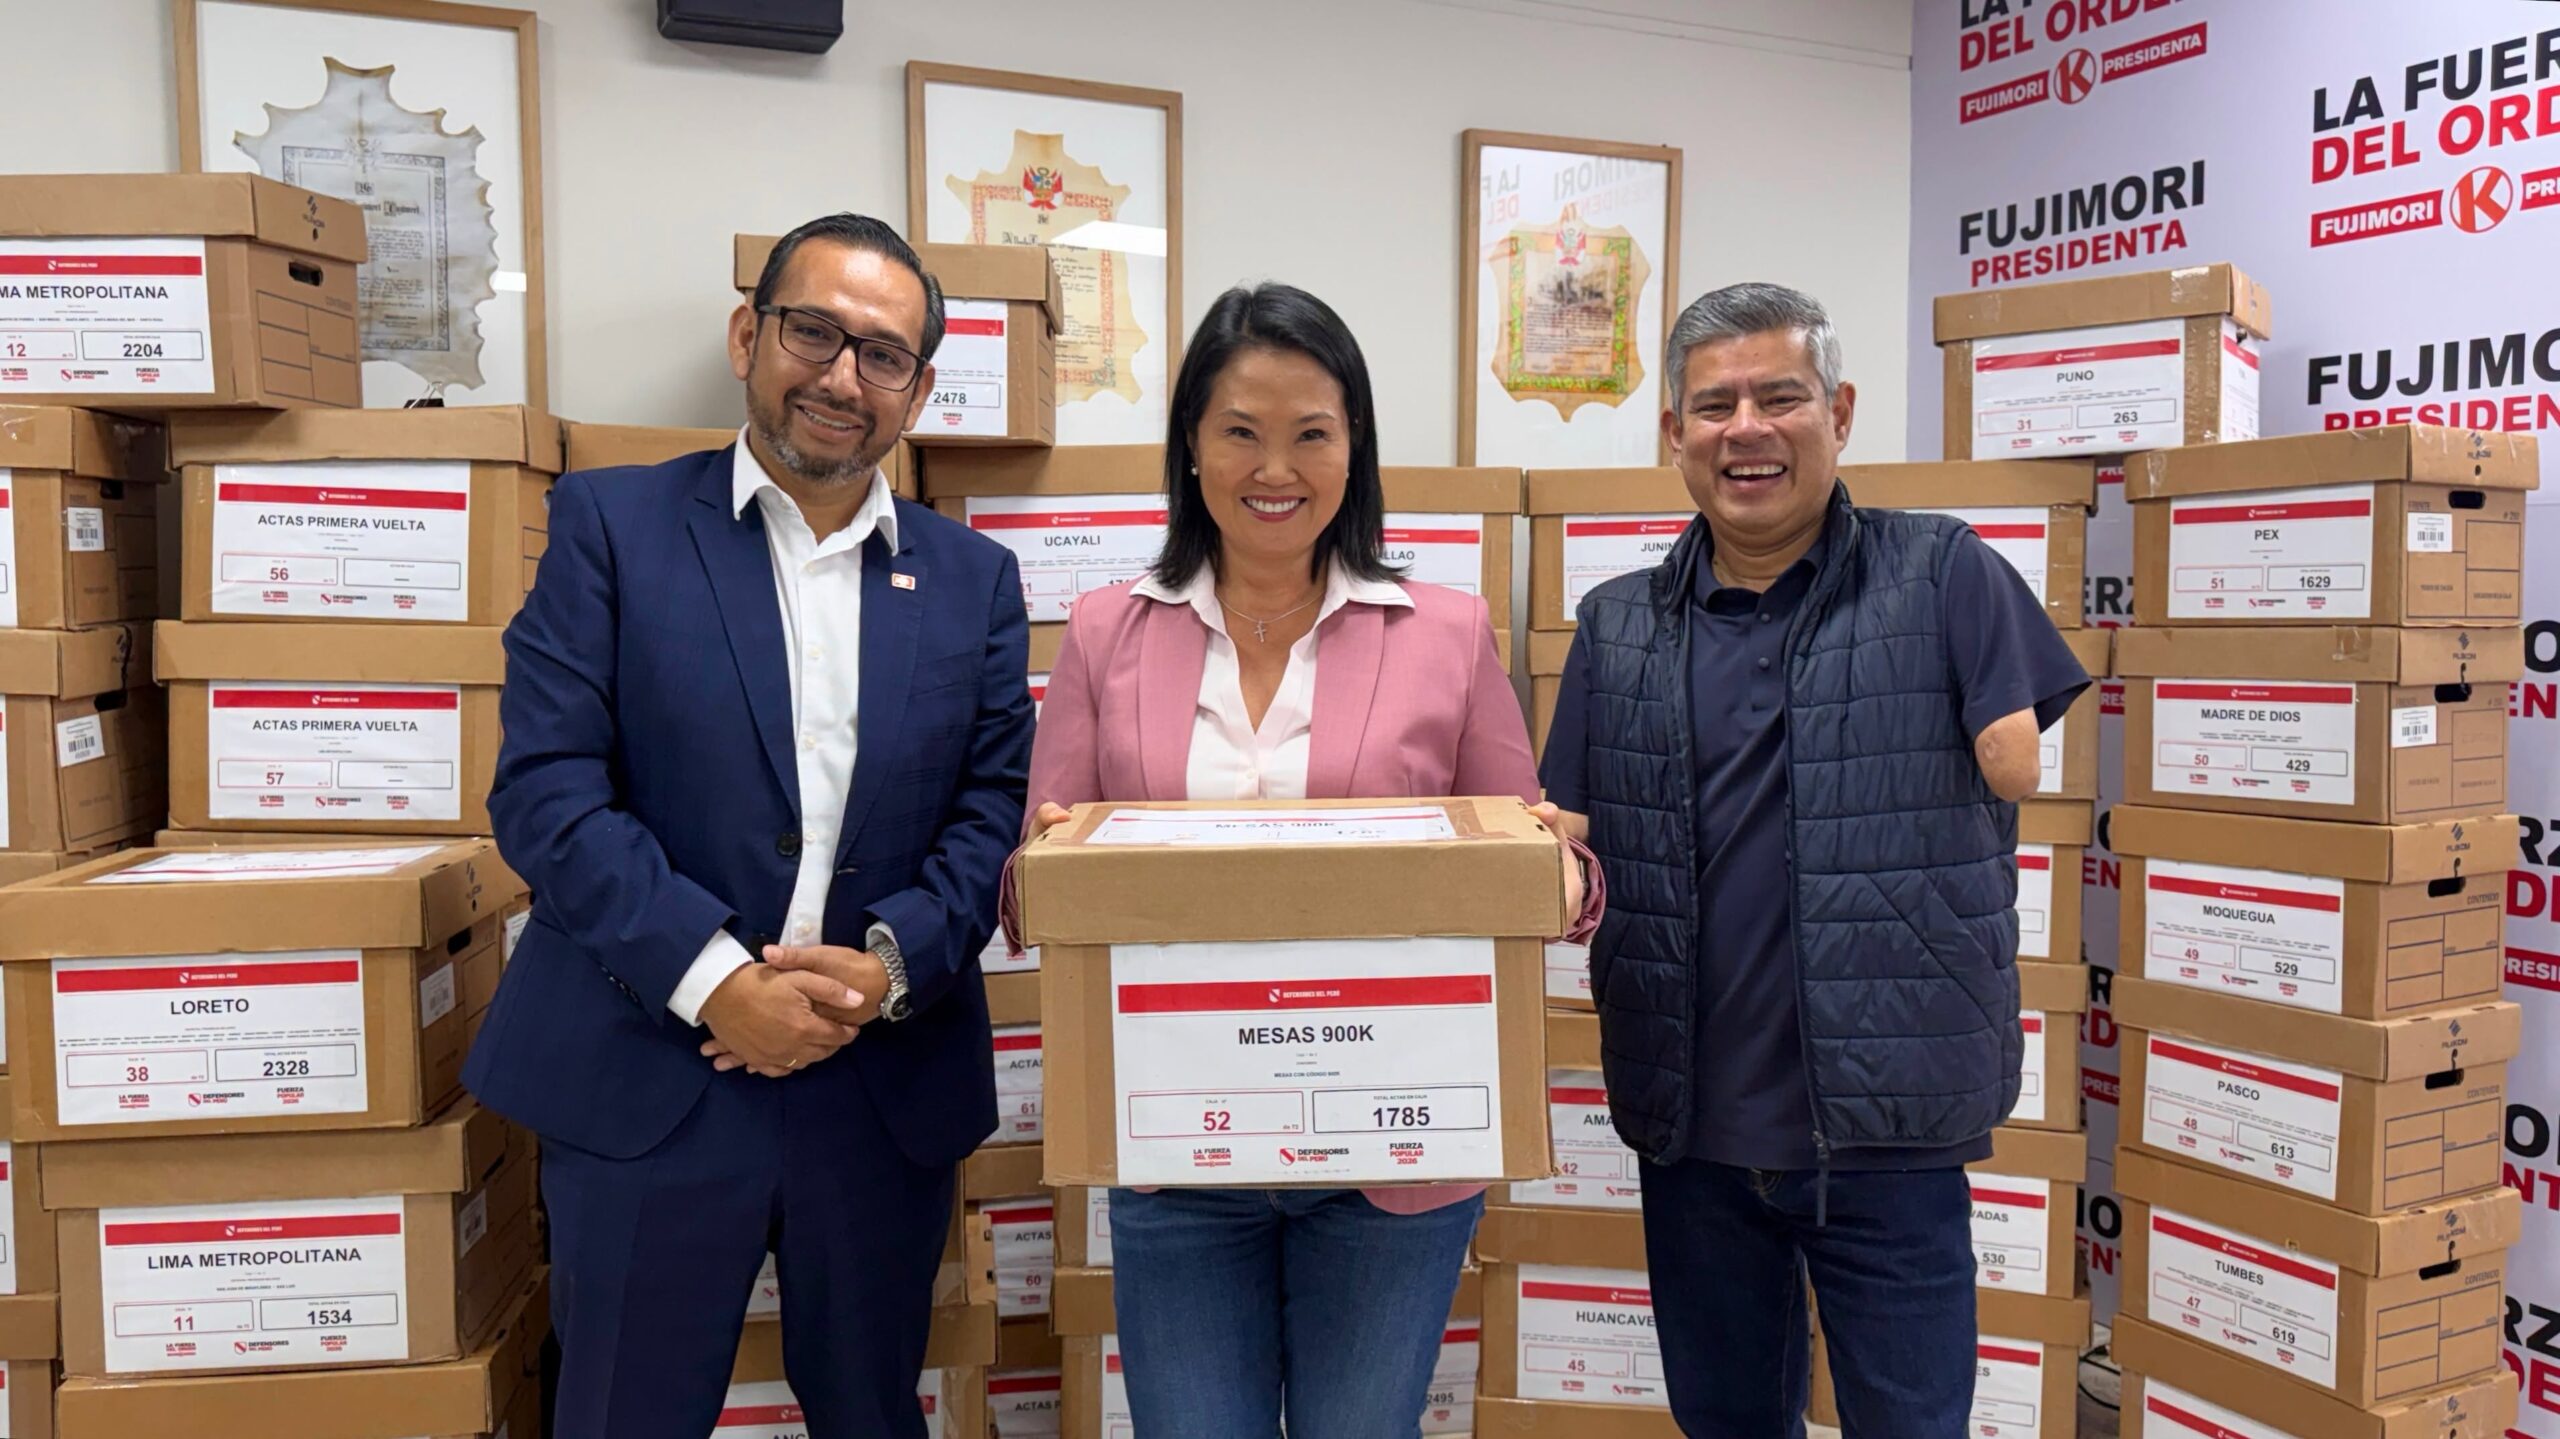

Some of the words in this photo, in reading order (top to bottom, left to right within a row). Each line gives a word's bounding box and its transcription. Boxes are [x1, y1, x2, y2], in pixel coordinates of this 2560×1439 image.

[1960, 15, 2034, 72] DEL
[2045, 0, 2184, 42] ORD
[1966, 79, 2043, 117] FUJIMORI
[2056, 48, 2096, 104] K
[2104, 33, 2202, 74] PRESIDENTA
[2313, 75, 2385, 133] LA
[2312, 120, 2421, 184] DEL
[1960, 160, 2205, 255] FUJIMORI
[2320, 199, 2434, 239] FUJIMORI
[2451, 166, 2512, 233] K
[1971, 219, 2188, 288] PRESIDENTA
[26, 286, 169, 299] METROPOLITANA
[7, 344, 26, 357] 12
[123, 344, 163, 357] 2204
[2056, 370, 2094, 383] PUNO
[933, 392, 967, 404] 2478
[2017, 419, 2032, 430] 31
[2113, 412, 2138, 424] 263
[258, 514, 304, 526] ACTAS
[307, 516, 369, 529] PRIMERA
[373, 518, 426, 531] VUELTA
[1044, 535, 1101, 547] UCAYALI
[2254, 529, 2279, 541] PEX
[1379, 550, 1415, 560] LLAO
[270, 568, 289, 581] 56
[2211, 578, 2224, 589] 51
[2299, 576, 2331, 588] 1629
[2201, 708, 2245, 721] MADRE
[2249, 709, 2266, 721] DE
[2269, 710, 2301, 722] DIOS
[252, 720, 298, 731] ACTAS
[302, 720, 362, 731] PRIMERA
[365, 721, 418, 731] VUELTA
[2194, 755, 2209, 766] 50
[2286, 759, 2311, 772] 429
[266, 772, 284, 785] 57
[2203, 905, 2275, 925] MOQUEGUA
[2184, 948, 2199, 960] 49
[2274, 961, 2298, 976] 529
[170, 998, 250, 1015] LORETO
[1238, 1026, 1315, 1045] MESAS
[1322, 1024, 1375, 1043] 900K
[126, 1066, 149, 1082] 38
[262, 1060, 310, 1077] 2328
[2217, 1080, 2260, 1101] PASCO
[1021, 1103, 1036, 1114] 61
[1203, 1111, 1231, 1131] 52
[1372, 1106, 1431, 1127] 1785
[2183, 1117, 2198, 1130] 48
[2271, 1142, 2295, 1159] 613
[1561, 1163, 1578, 1175] 42
[1015, 1231, 1052, 1242] ACTAS
[148, 1253, 193, 1269] LIMA
[199, 1248, 362, 1268] METROPOLITANA
[1982, 1252, 2005, 1265] 530
[1026, 1275, 1041, 1286] 60
[2215, 1259, 2264, 1285] TUMBES
[174, 1316, 194, 1331] 11
[307, 1309, 352, 1325] 1534
[2186, 1295, 2201, 1309] 47
[2272, 1327, 2295, 1344] 619
[1568, 1360, 1585, 1371] 45
[1427, 1392, 1454, 1404] 2495
[1015, 1402, 1051, 1412] ACTAS
